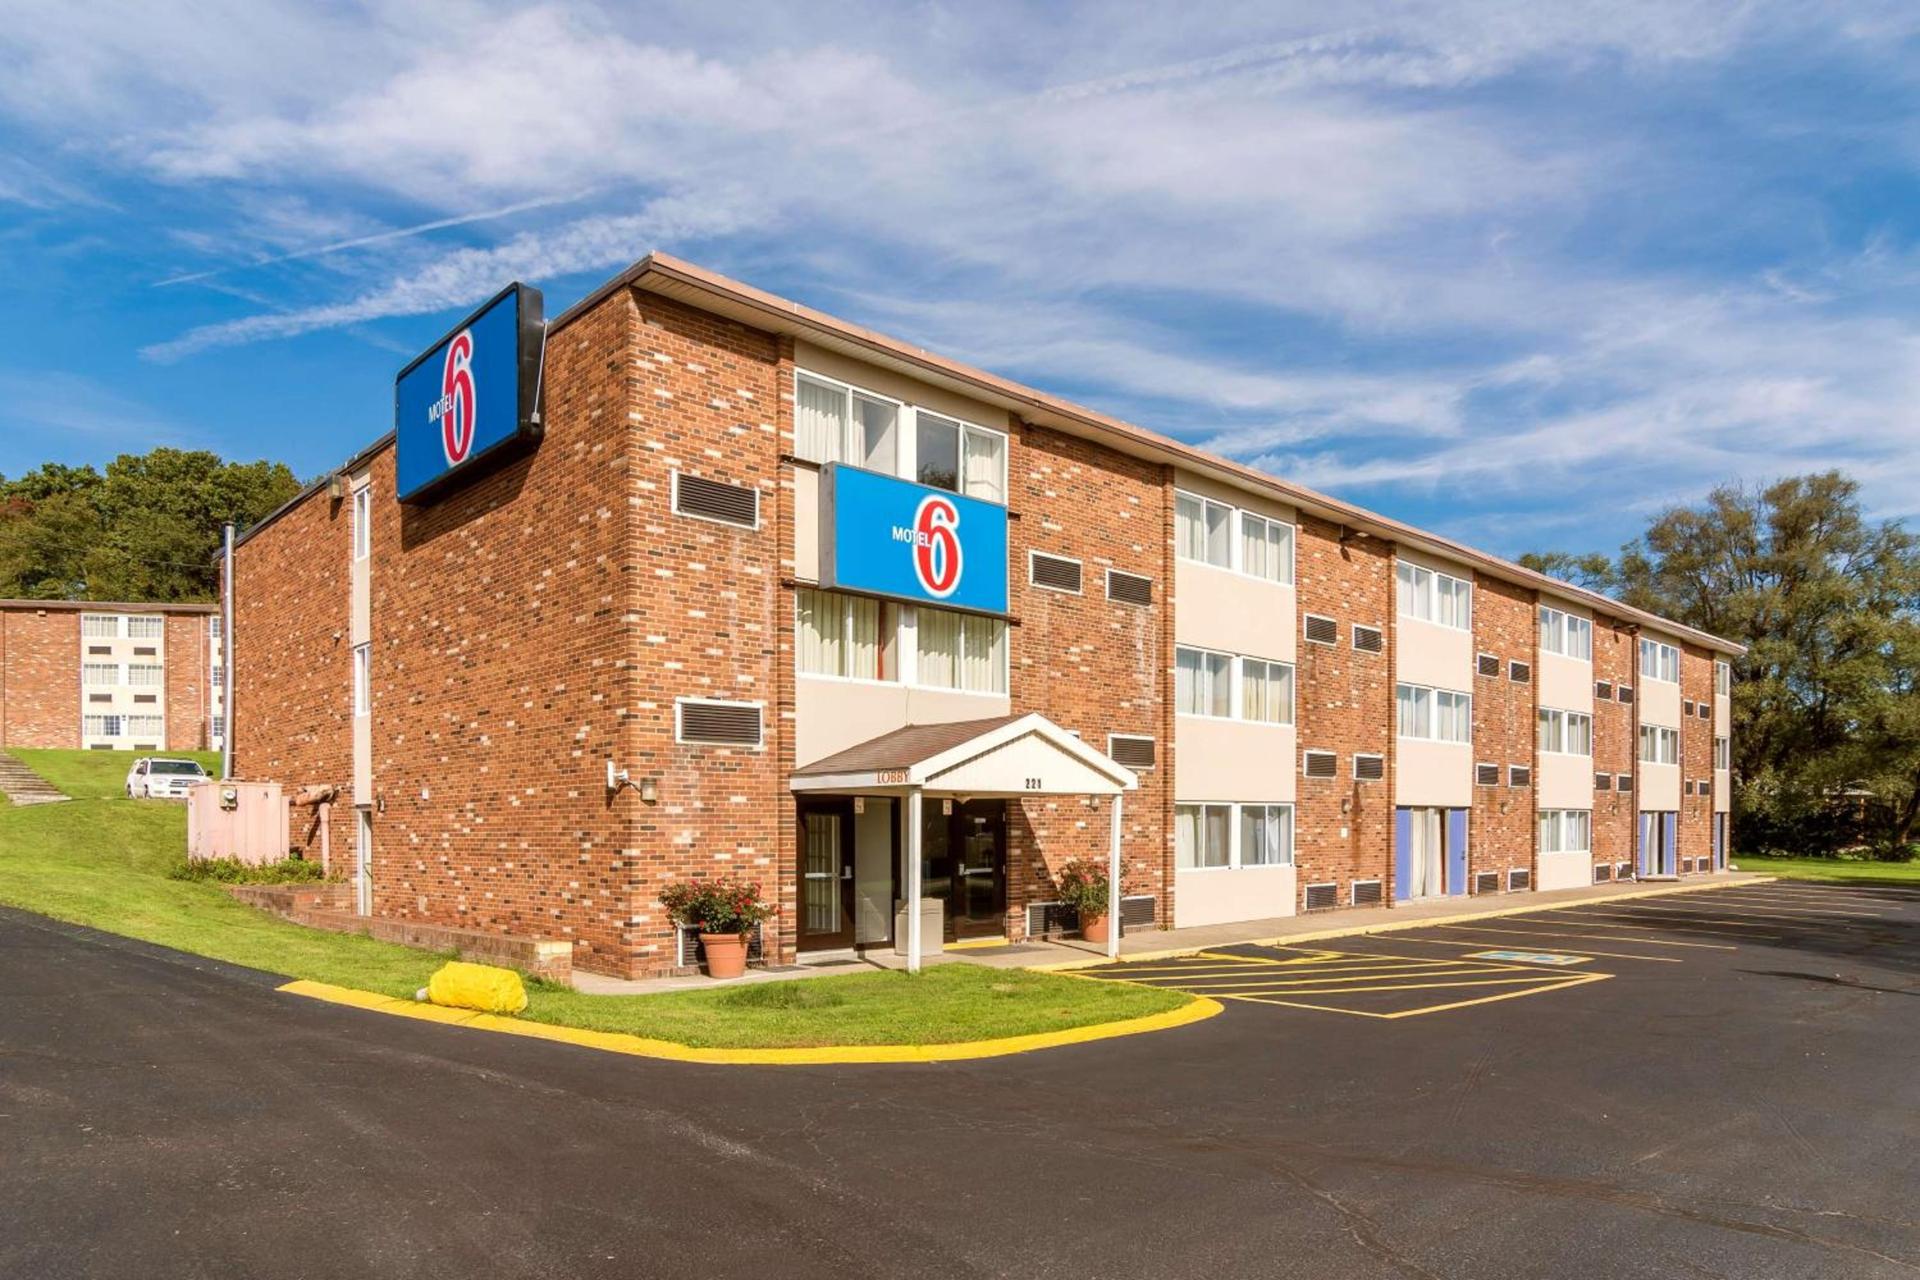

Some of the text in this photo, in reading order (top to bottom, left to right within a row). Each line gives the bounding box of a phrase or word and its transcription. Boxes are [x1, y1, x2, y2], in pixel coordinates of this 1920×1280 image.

[429, 329, 476, 467] MOTEL 6
[892, 495, 963, 598] MOTEL 6
[877, 769, 909, 784] LOBBY
[1025, 777, 1042, 789] 221
